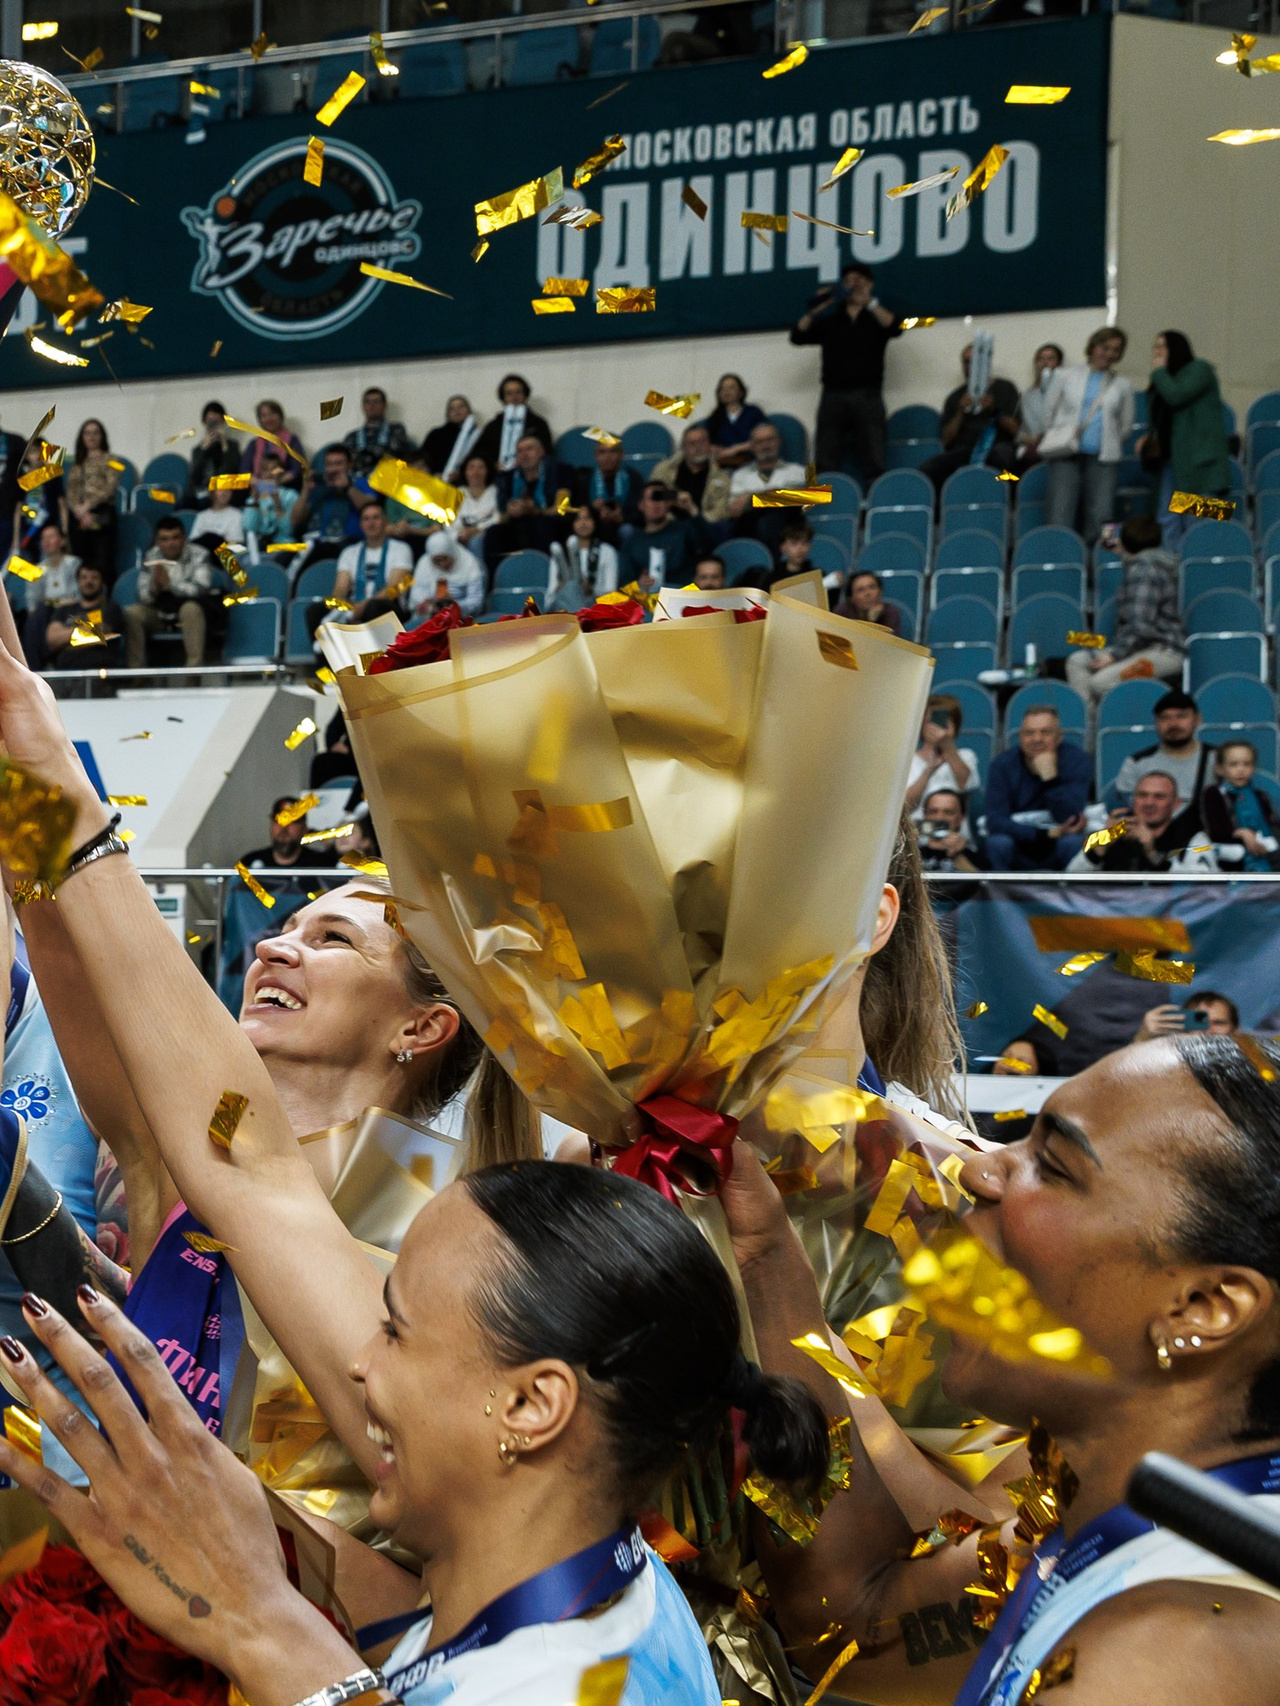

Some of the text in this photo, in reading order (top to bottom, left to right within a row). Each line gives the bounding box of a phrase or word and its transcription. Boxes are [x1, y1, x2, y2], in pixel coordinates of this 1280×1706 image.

[829, 95, 980, 148] ОБЛАСТЬ
[203, 204, 418, 289] Заречье
[536, 139, 1041, 302] ОДИНЦОВО
